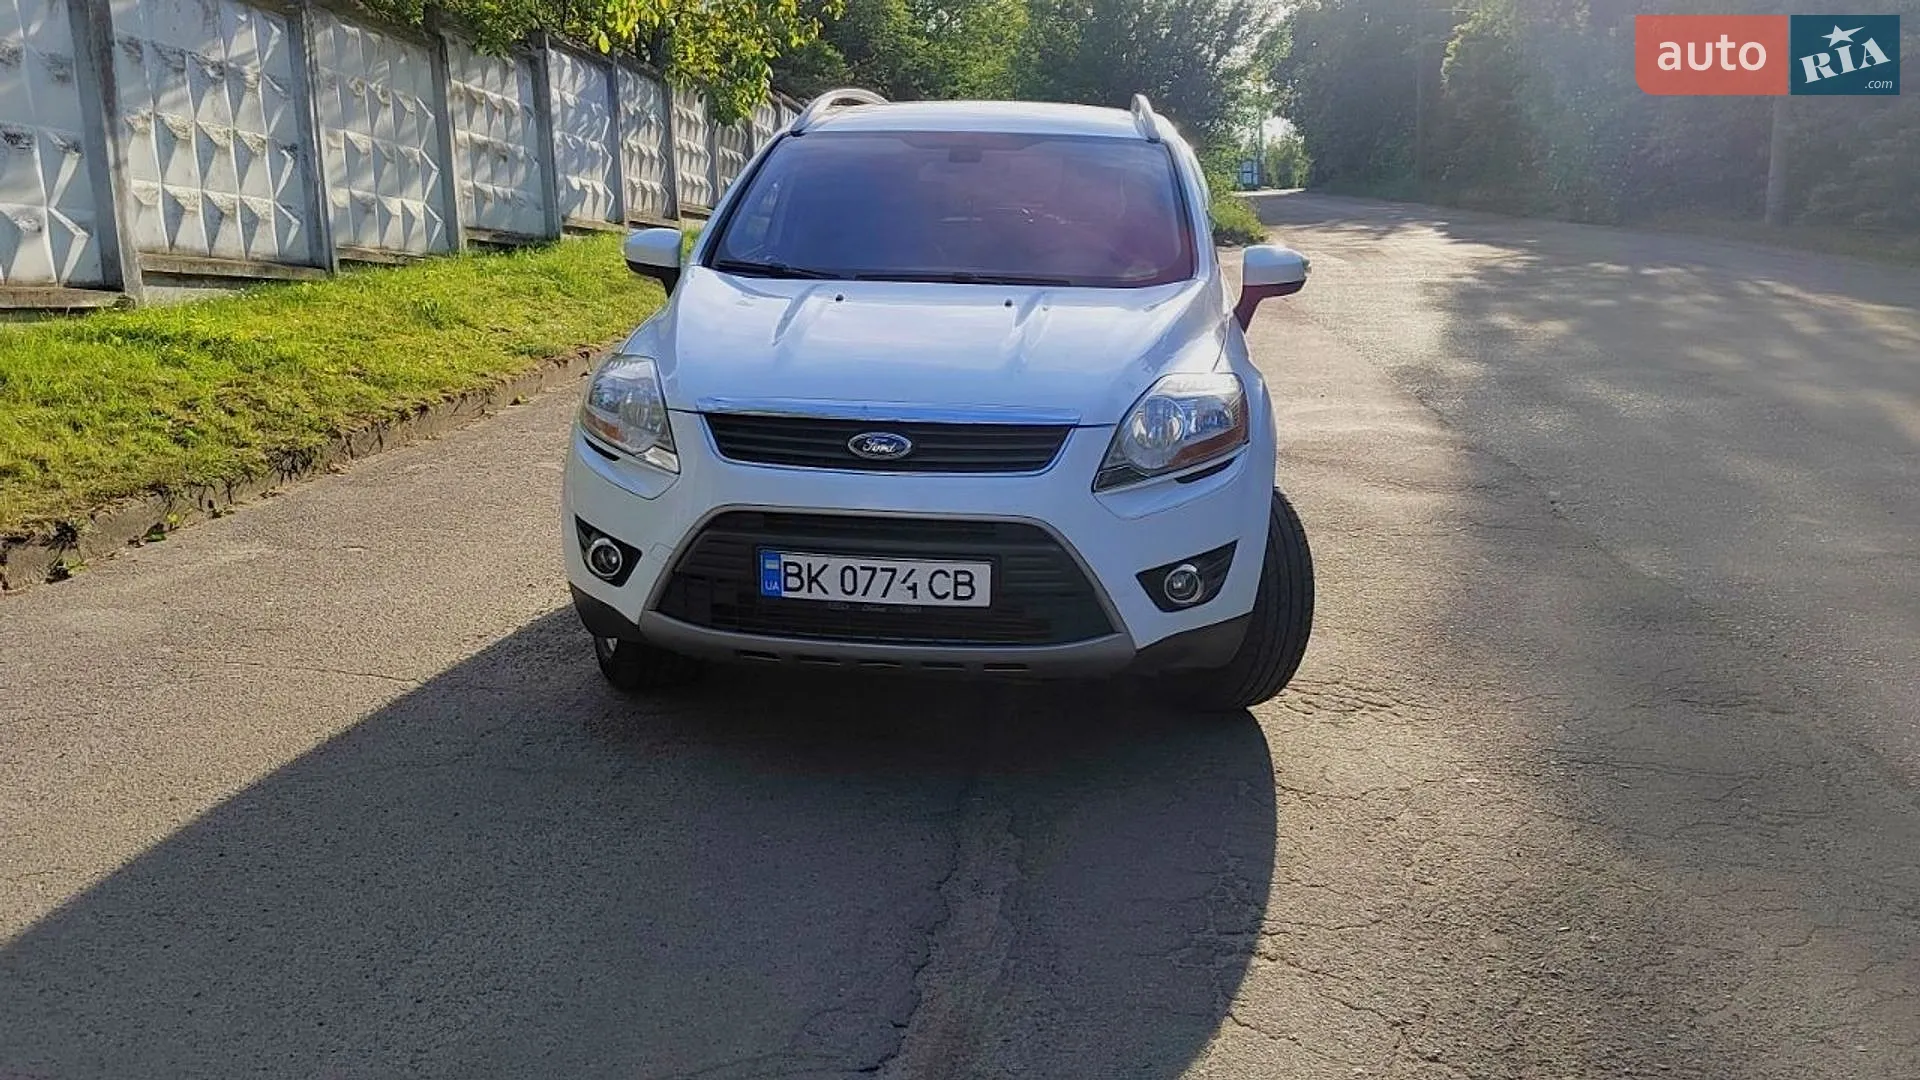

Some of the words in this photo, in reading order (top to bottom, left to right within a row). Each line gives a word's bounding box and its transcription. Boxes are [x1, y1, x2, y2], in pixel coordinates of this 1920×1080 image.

[765, 580, 780, 591] UA
[783, 561, 829, 595] BK
[928, 568, 976, 601] CB
